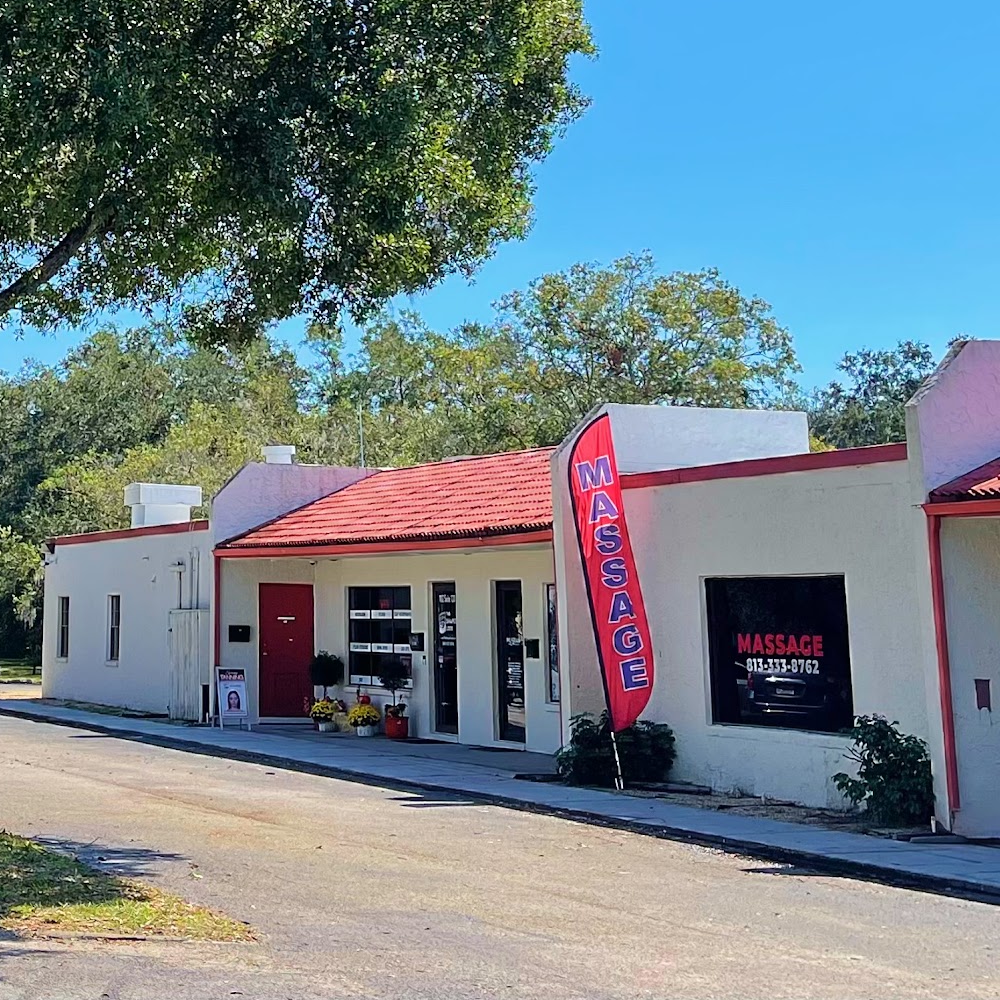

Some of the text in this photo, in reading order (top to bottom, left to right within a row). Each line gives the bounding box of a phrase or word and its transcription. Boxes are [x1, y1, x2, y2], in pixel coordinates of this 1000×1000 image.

[575, 455, 650, 692] MASSAGE
[737, 633, 824, 657] MASSAGE
[746, 658, 820, 675] 813-333-8762
